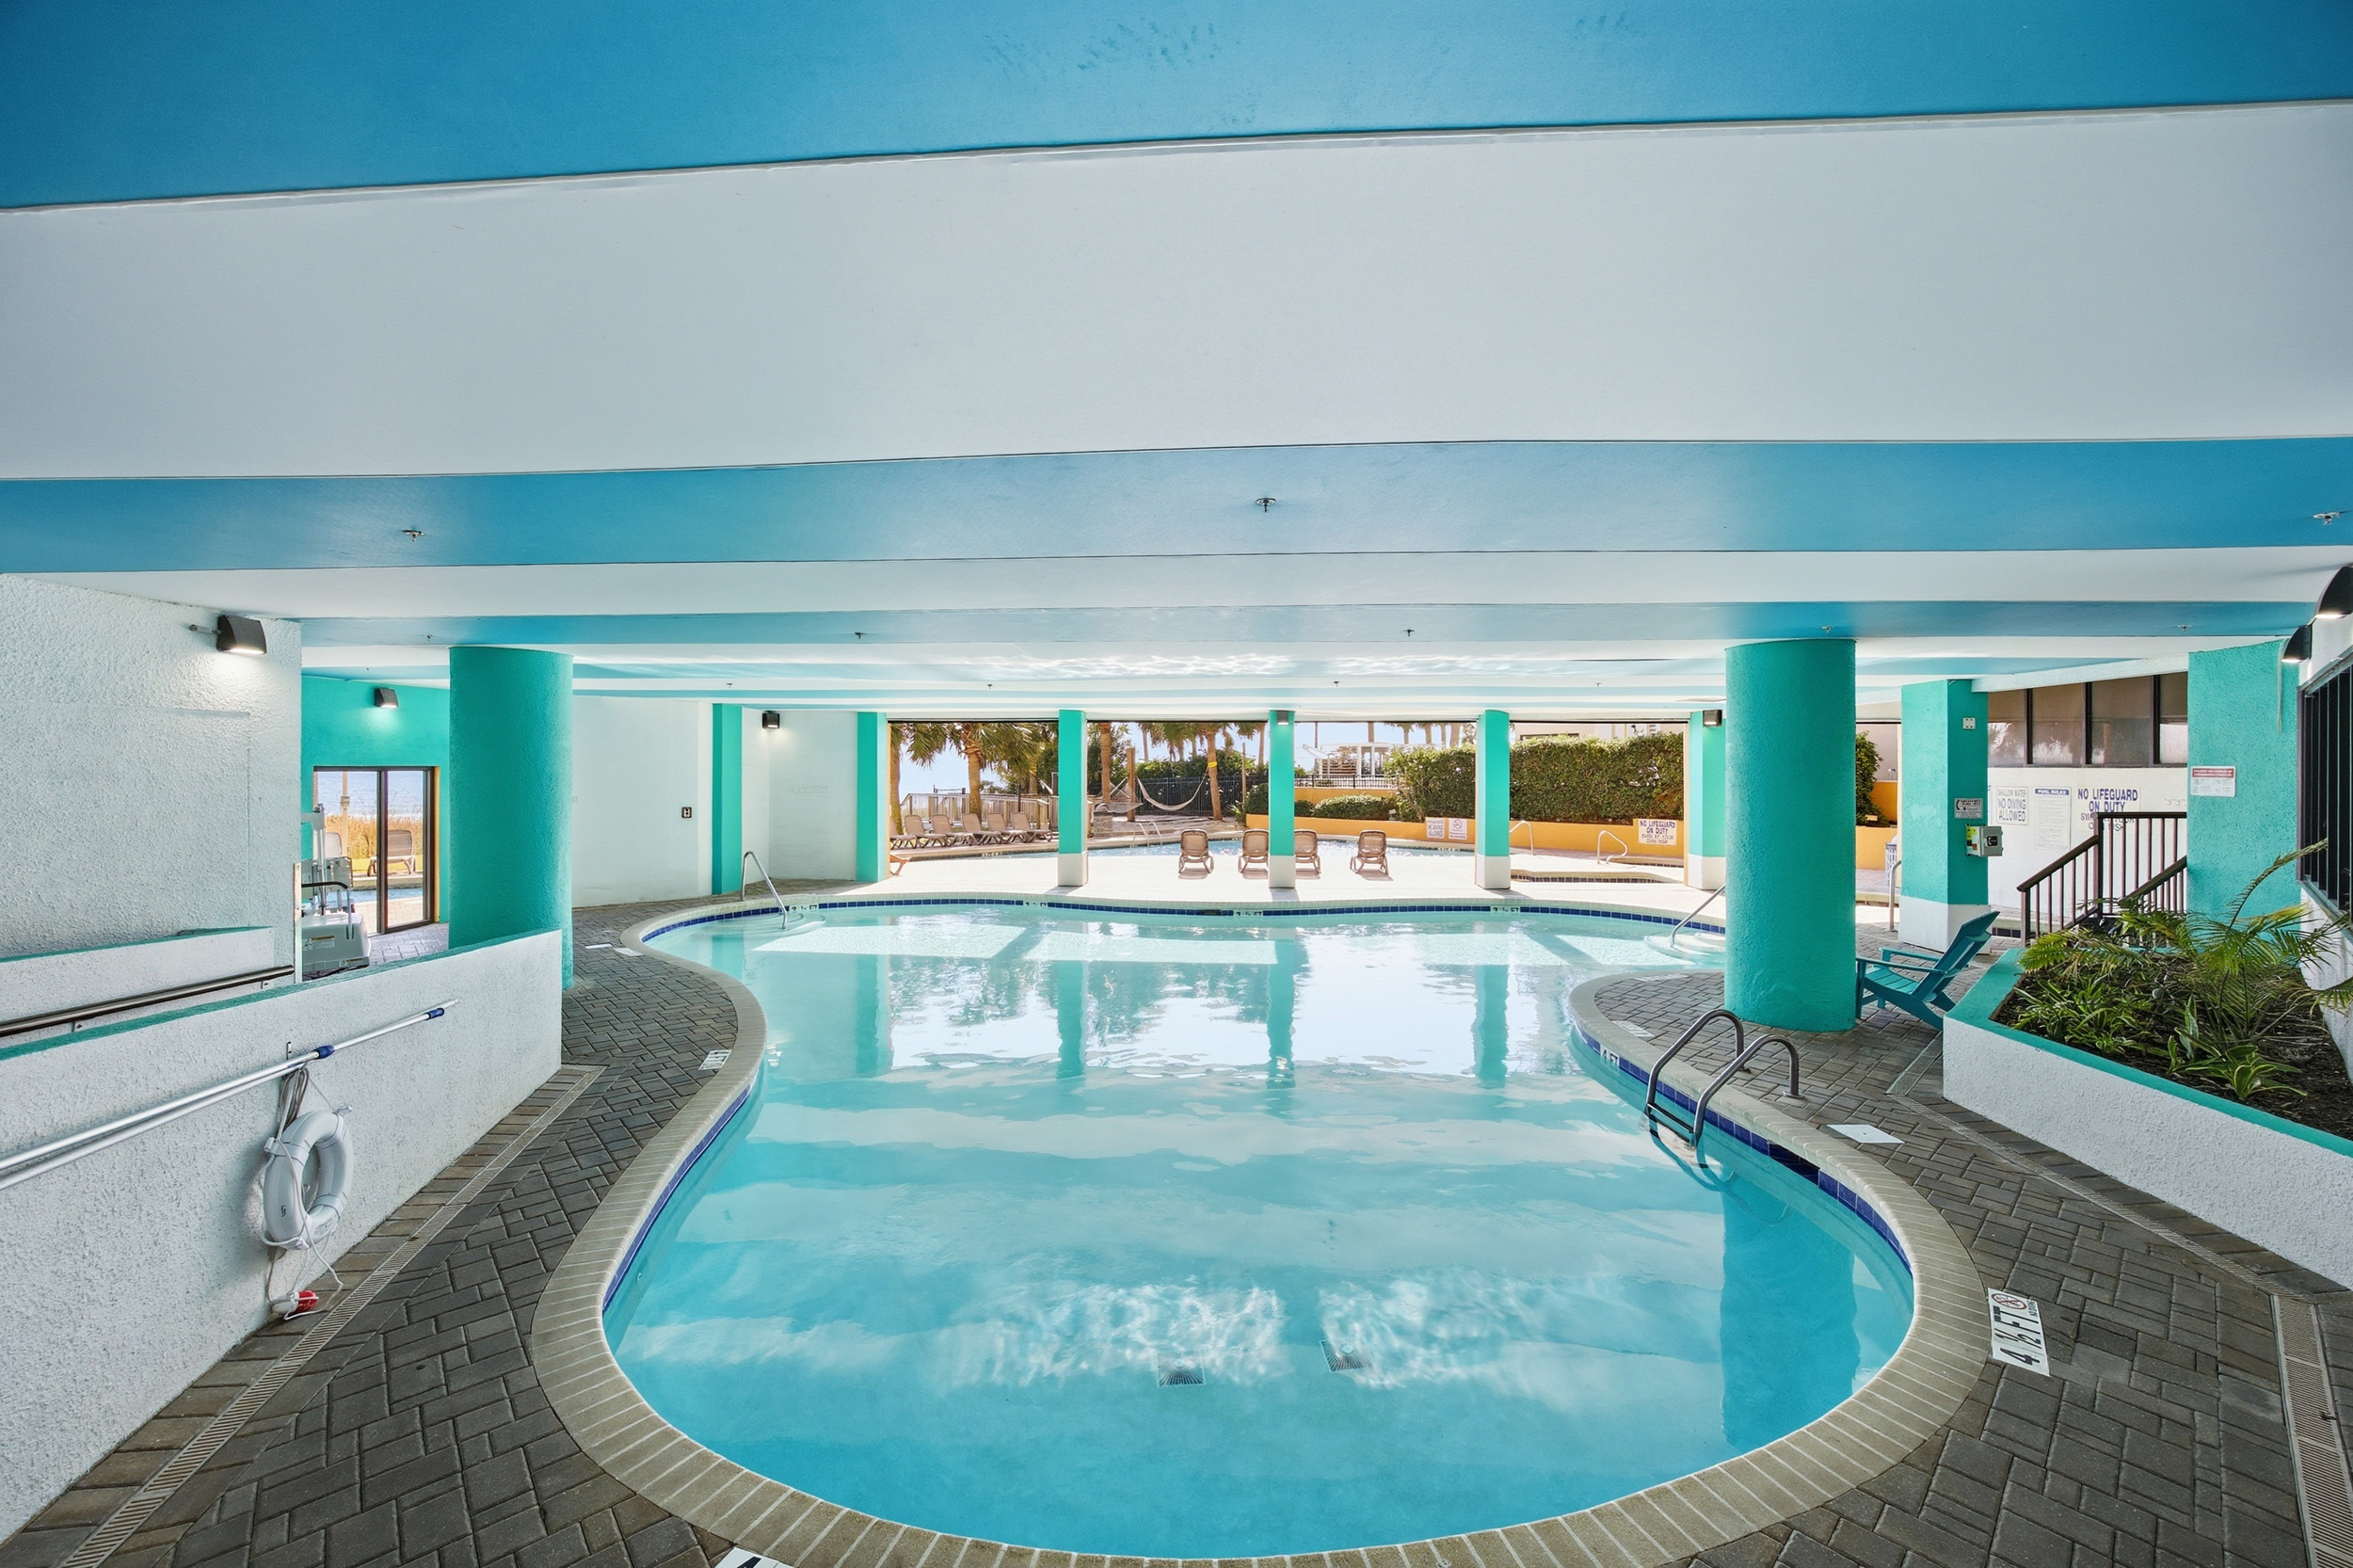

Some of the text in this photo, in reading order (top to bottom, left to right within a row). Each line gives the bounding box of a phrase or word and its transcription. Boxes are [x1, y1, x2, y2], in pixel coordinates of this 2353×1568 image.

[2077, 788, 2138, 801] NO LIFEGUARD
[1998, 797, 2026, 810] NO DIVING
[2089, 800, 2126, 813] ON DUTY
[1998, 809, 2026, 822] ALLOWED
[1993, 1304, 2041, 1335] FT
[1999, 1347, 2041, 1366] 4
